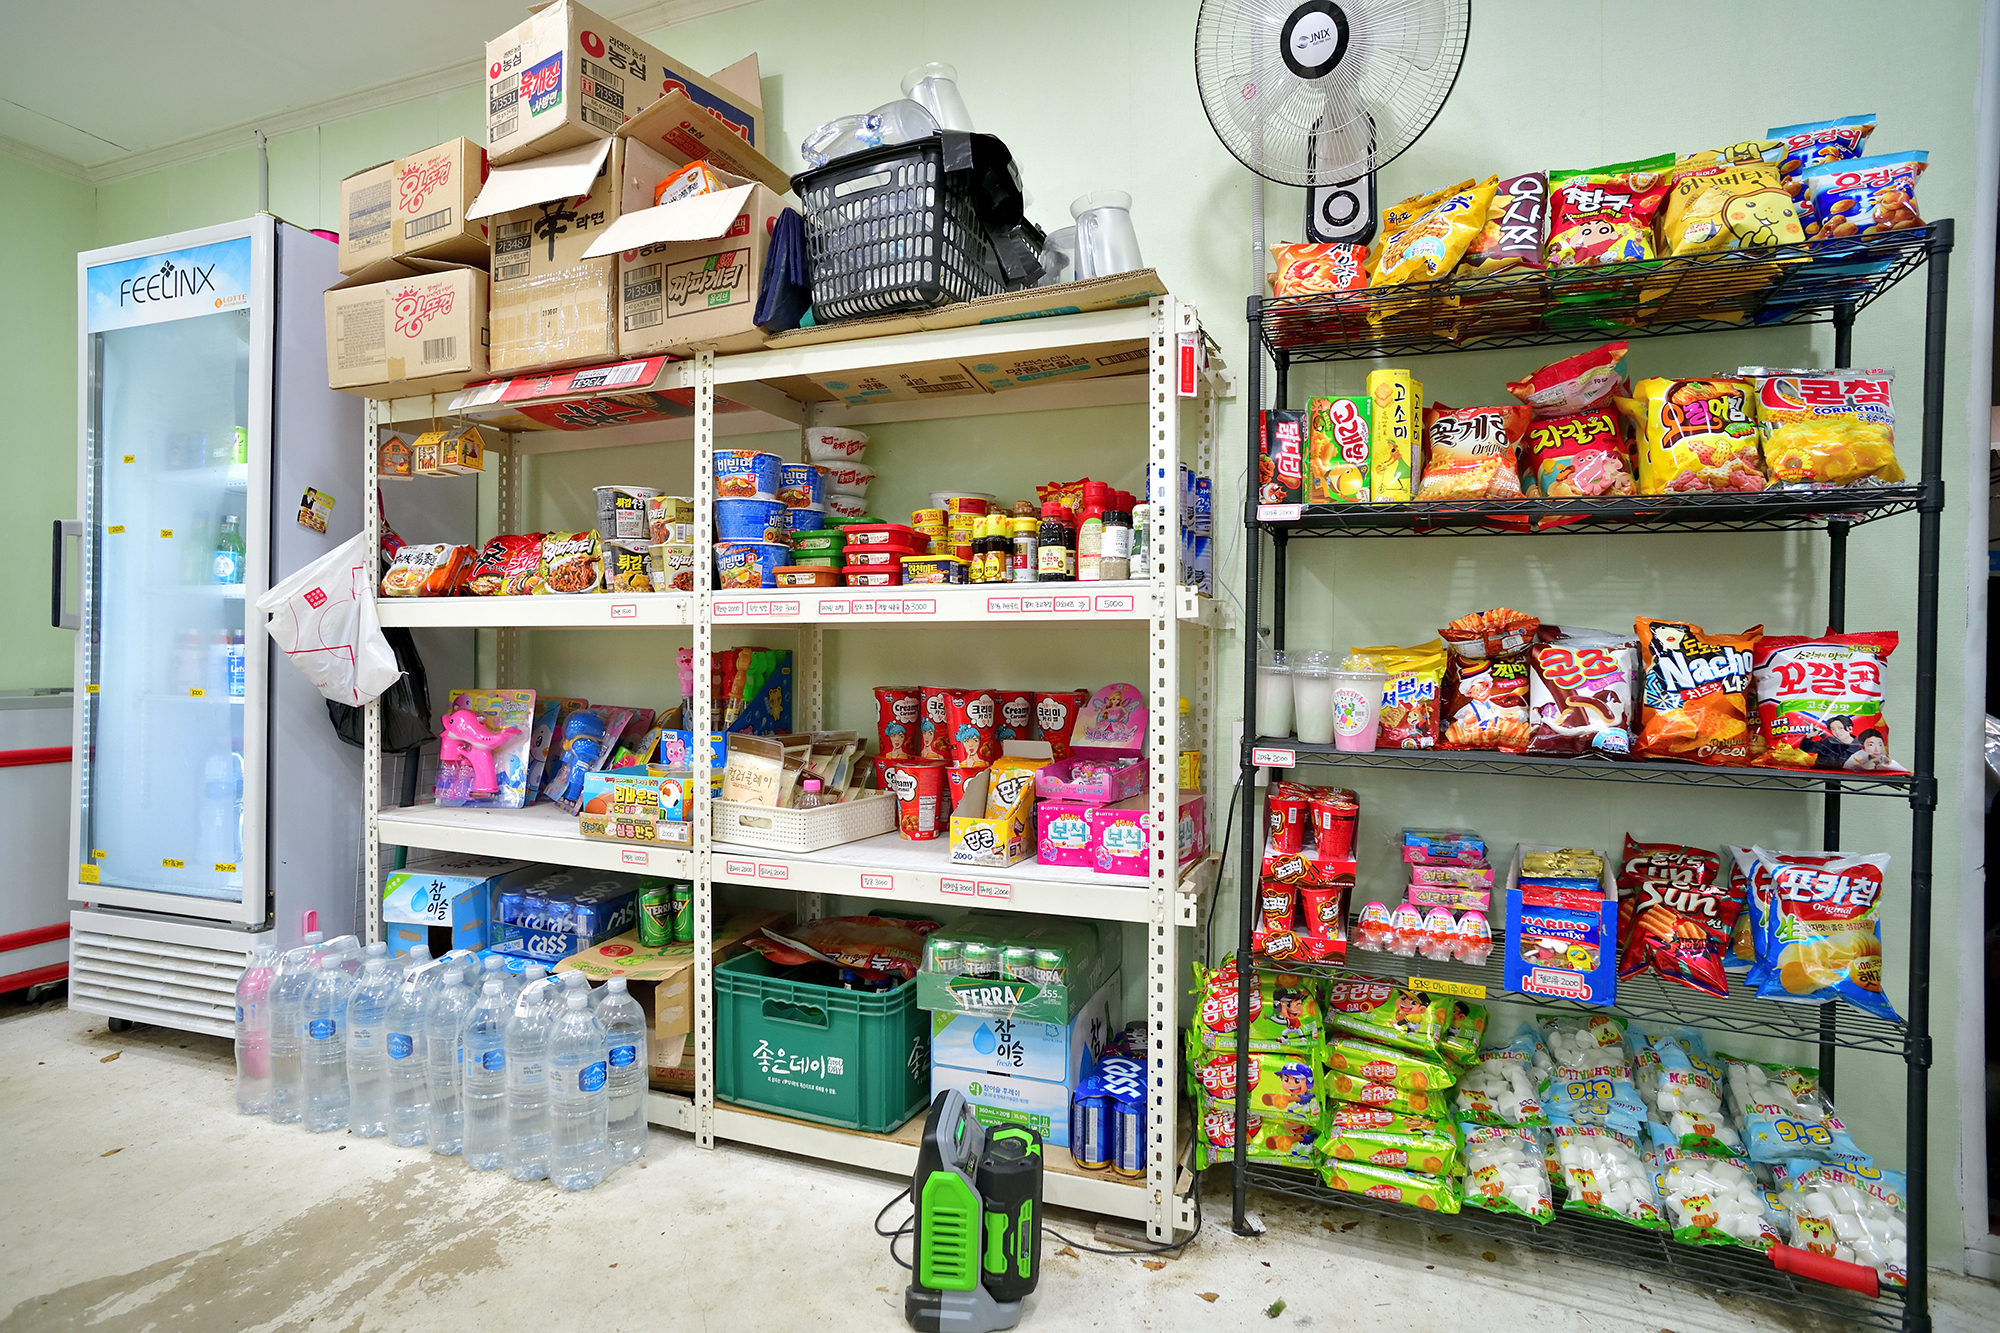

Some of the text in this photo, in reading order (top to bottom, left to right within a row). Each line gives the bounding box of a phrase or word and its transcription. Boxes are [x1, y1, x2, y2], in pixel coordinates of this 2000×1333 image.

[1310, 28, 1331, 43] JNIX
[503, 52, 522, 72] 농심
[608, 45, 646, 81] 농심
[519, 61, 560, 99] 육개장
[532, 90, 558, 113] 사발면
[1788, 129, 1862, 151] 오징어
[399, 161, 452, 213] 왕뚜껑
[1827, 165, 1918, 195] 오징어
[1562, 187, 1634, 213] 짱구
[576, 211, 605, 230] 라면
[1499, 177, 1544, 251] 오사쯔
[120, 262, 216, 307] FEELINX
[668, 264, 744, 306] 짜파게티
[222, 293, 247, 304] LOTTE
[394, 291, 455, 338] 왕뚜껑
[1799, 378, 1890, 407] 콘칩
[1393, 383, 1408, 440] 고소미
[1814, 407, 1852, 415] CORN
[1333, 402, 1367, 461] 고래밥
[1530, 415, 1616, 455] 자갈치
[1276, 421, 1303, 480] 닭다리
[717, 459, 753, 473] 비빔면
[779, 471, 808, 485] 빔면
[1279, 508, 1294, 516] 2000
[541, 538, 595, 564] 짜파게티
[785, 604, 797, 612] 3000
[910, 602, 927, 611] 3000
[1104, 600, 1124, 608] 5000
[1659, 646, 1753, 692] Nacho
[1772, 661, 1882, 697] 꼬깔콘
[1381, 677, 1435, 709] 셔뿌셔
[895, 703, 920, 714] Creamy
[1273, 754, 1288, 762] 2000
[729, 766, 773, 789] 컬러클레이
[615, 785, 659, 806] 리바운드
[963, 828, 995, 851] 팝콘
[1050, 820, 1086, 842] 보석
[1106, 828, 1141, 850] 보석
[953, 851, 972, 860] 2000
[741, 865, 752, 873] 2000
[429, 878, 447, 895] 참
[875, 878, 888, 886] 3000
[994, 887, 1009, 896] 2000
[1780, 869, 1879, 907] 포카칩
[1638, 880, 1718, 916] Sun
[1812, 902, 1852, 915] Original
[427, 900, 449, 921] 이슬
[647, 904, 670, 916] TERRA
[1521, 915, 1590, 932] HARIBO
[1527, 927, 1582, 941] Starmix
[1776, 914, 1807, 943] 生
[1042, 989, 1058, 999] 355
[1330, 984, 1392, 1002] 홈런볼
[1461, 986, 1482, 996] 1000
[1561, 979, 1579, 988] 2000
[956, 985, 1019, 1010] TERRA
[994, 1018, 1016, 1040] 참
[753, 1039, 825, 1079] 좋은데이
[997, 1041, 1024, 1067] 이슬
[1360, 1063, 1398, 1079] 홈런볼
[1369, 1152, 1408, 1166] 홈런볼
[1363, 1187, 1403, 1200] 홈런볼
